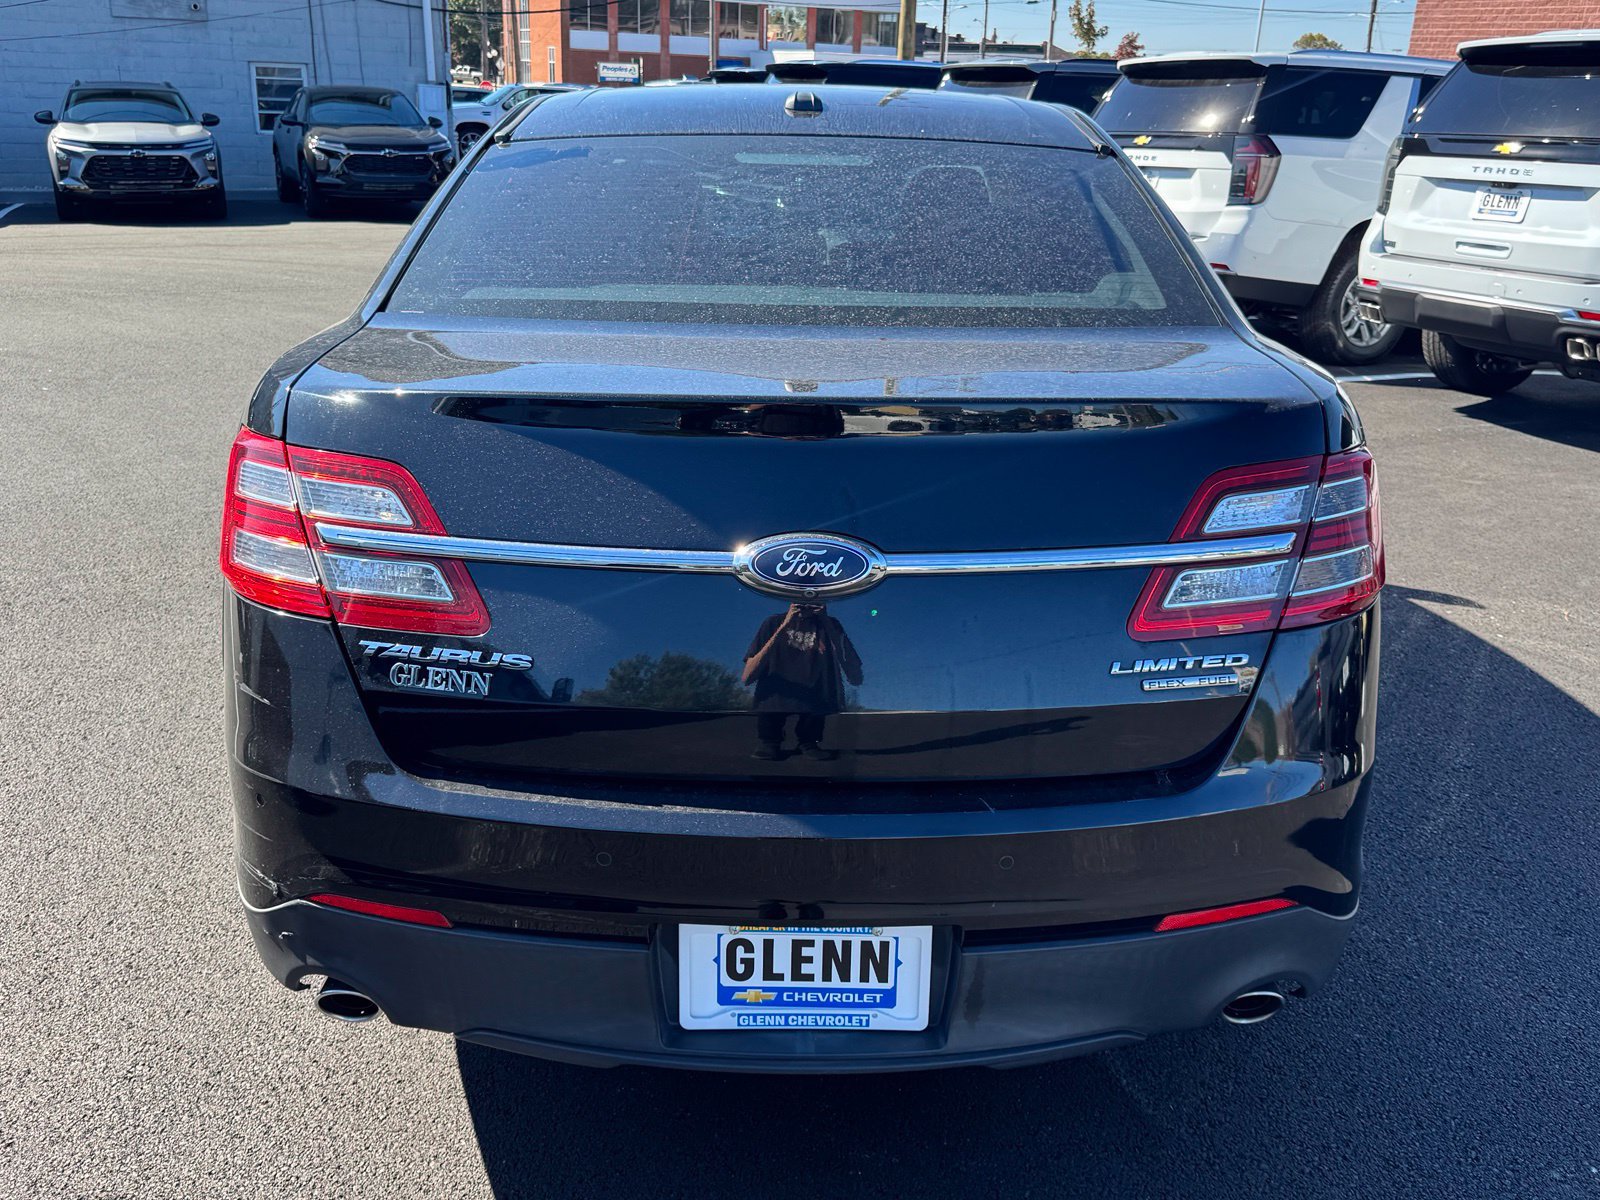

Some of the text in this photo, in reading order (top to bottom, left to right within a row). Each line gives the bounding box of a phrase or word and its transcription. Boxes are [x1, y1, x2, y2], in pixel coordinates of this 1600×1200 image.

[602, 65, 628, 73] Peoples
[1472, 165, 1534, 177] TAHOE
[1482, 194, 1521, 210] GLENN
[775, 547, 843, 578] Ford
[357, 639, 535, 672] TAURUS
[1110, 652, 1250, 675] LIMITED
[388, 661, 494, 697] GLENN
[1148, 675, 1236, 689] FLEX FUEL
[725, 937, 890, 984] GLENN
[782, 991, 884, 1004] CHEVROLET
[739, 1015, 869, 1027] GLENN CHEVROLET
